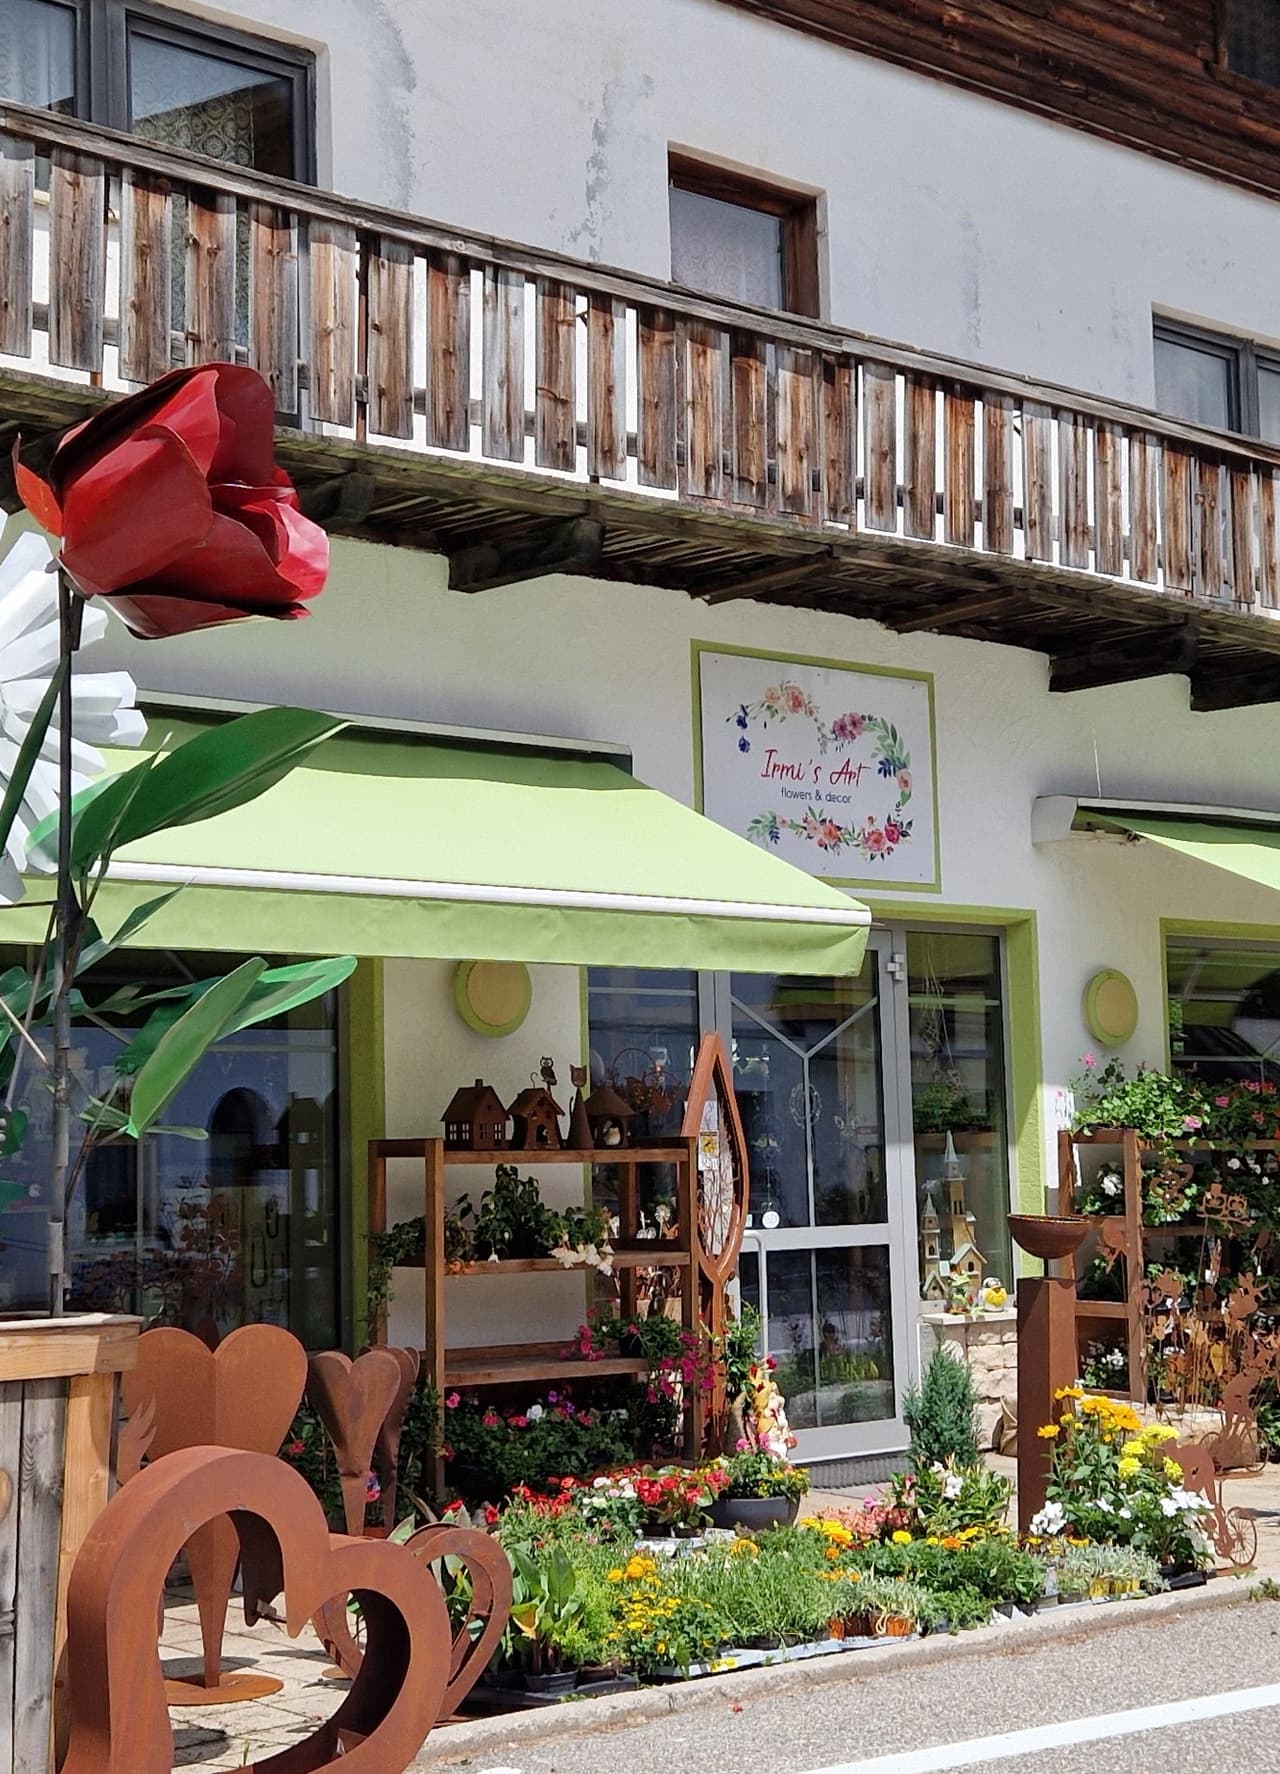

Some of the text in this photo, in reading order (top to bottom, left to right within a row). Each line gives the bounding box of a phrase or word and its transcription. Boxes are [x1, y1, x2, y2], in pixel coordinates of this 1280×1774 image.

[760, 748, 873, 788] Irmi's Art
[781, 786, 852, 804] flowers & decor
